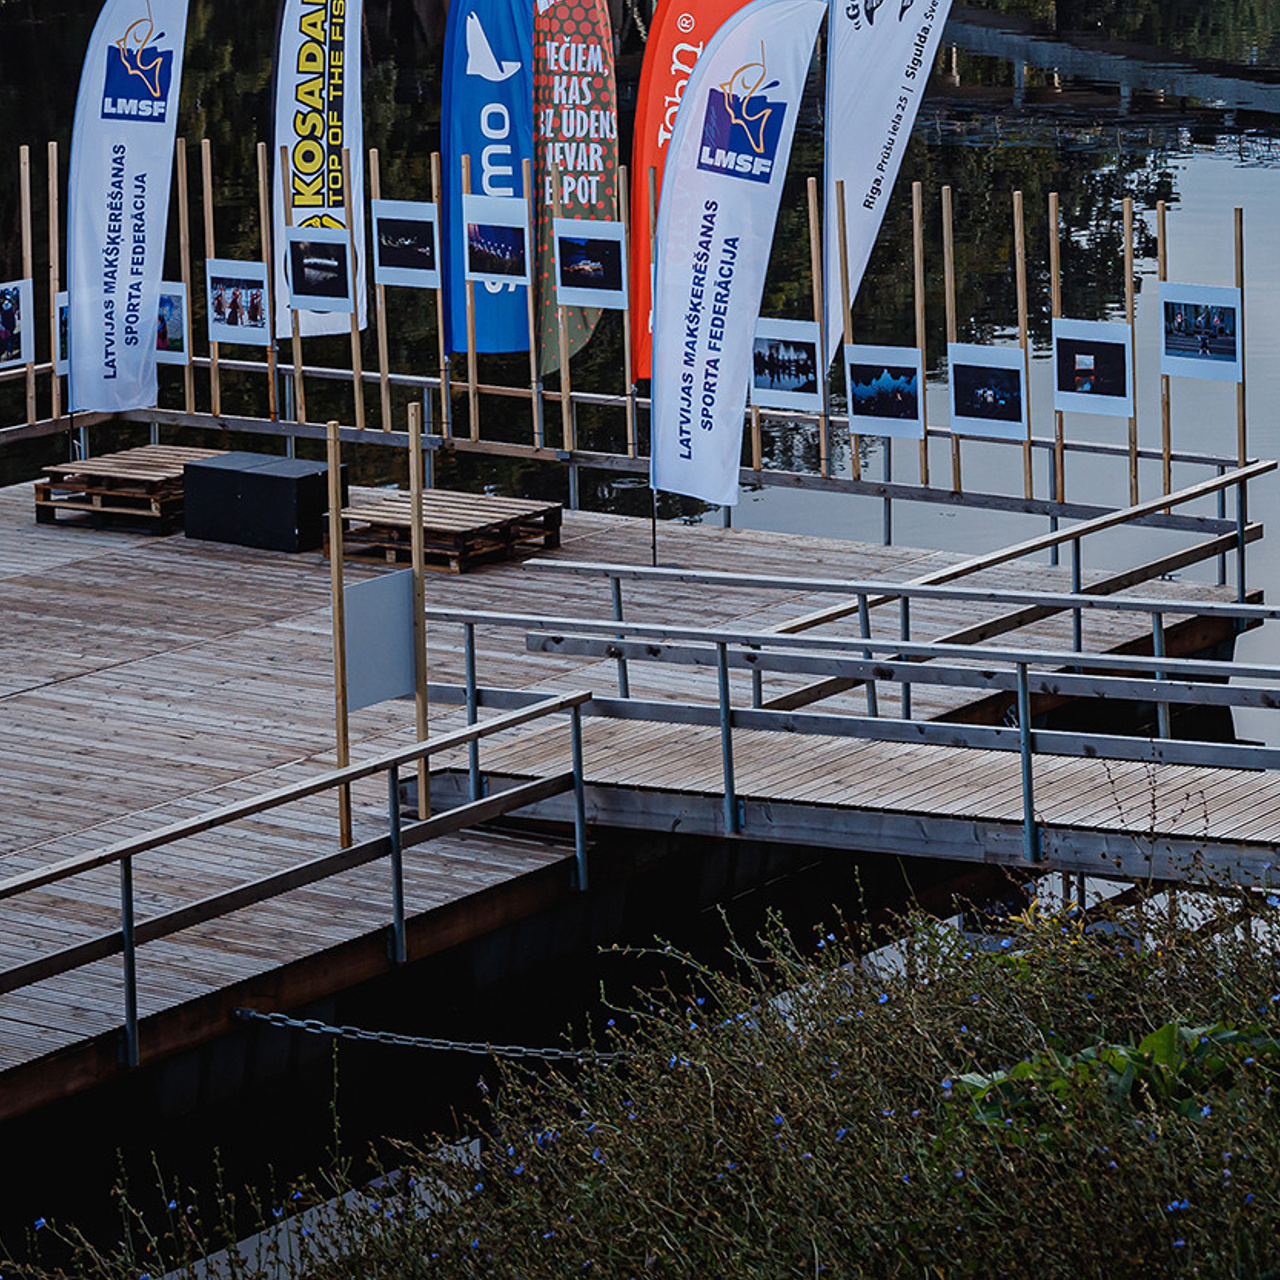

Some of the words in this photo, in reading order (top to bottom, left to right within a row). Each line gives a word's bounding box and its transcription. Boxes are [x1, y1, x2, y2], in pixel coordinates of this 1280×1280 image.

[103, 97, 166, 117] LMSF
[329, 51, 344, 101] THE
[553, 76, 592, 106] KAS
[887, 113, 903, 136] iela
[896, 95, 908, 111] 25
[904, 23, 933, 80] Sigulda,
[328, 111, 343, 146] OF
[562, 105, 618, 140] ŪDENS
[328, 154, 343, 206] TOP
[700, 146, 773, 176] LMSF
[102, 144, 126, 294] MAKŠĶERĒŠANAS
[130, 172, 148, 276] FEDERĀCIJA
[125, 281, 142, 346] SPORTA
[683, 200, 719, 367] MAKŠĶERĒŠANAS
[708, 237, 740, 352] FEDERĀCIJA
[103, 299, 117, 379] LATVIJAS
[679, 372, 694, 460] LATVIJAS
[700, 358, 721, 431] SPORTA
